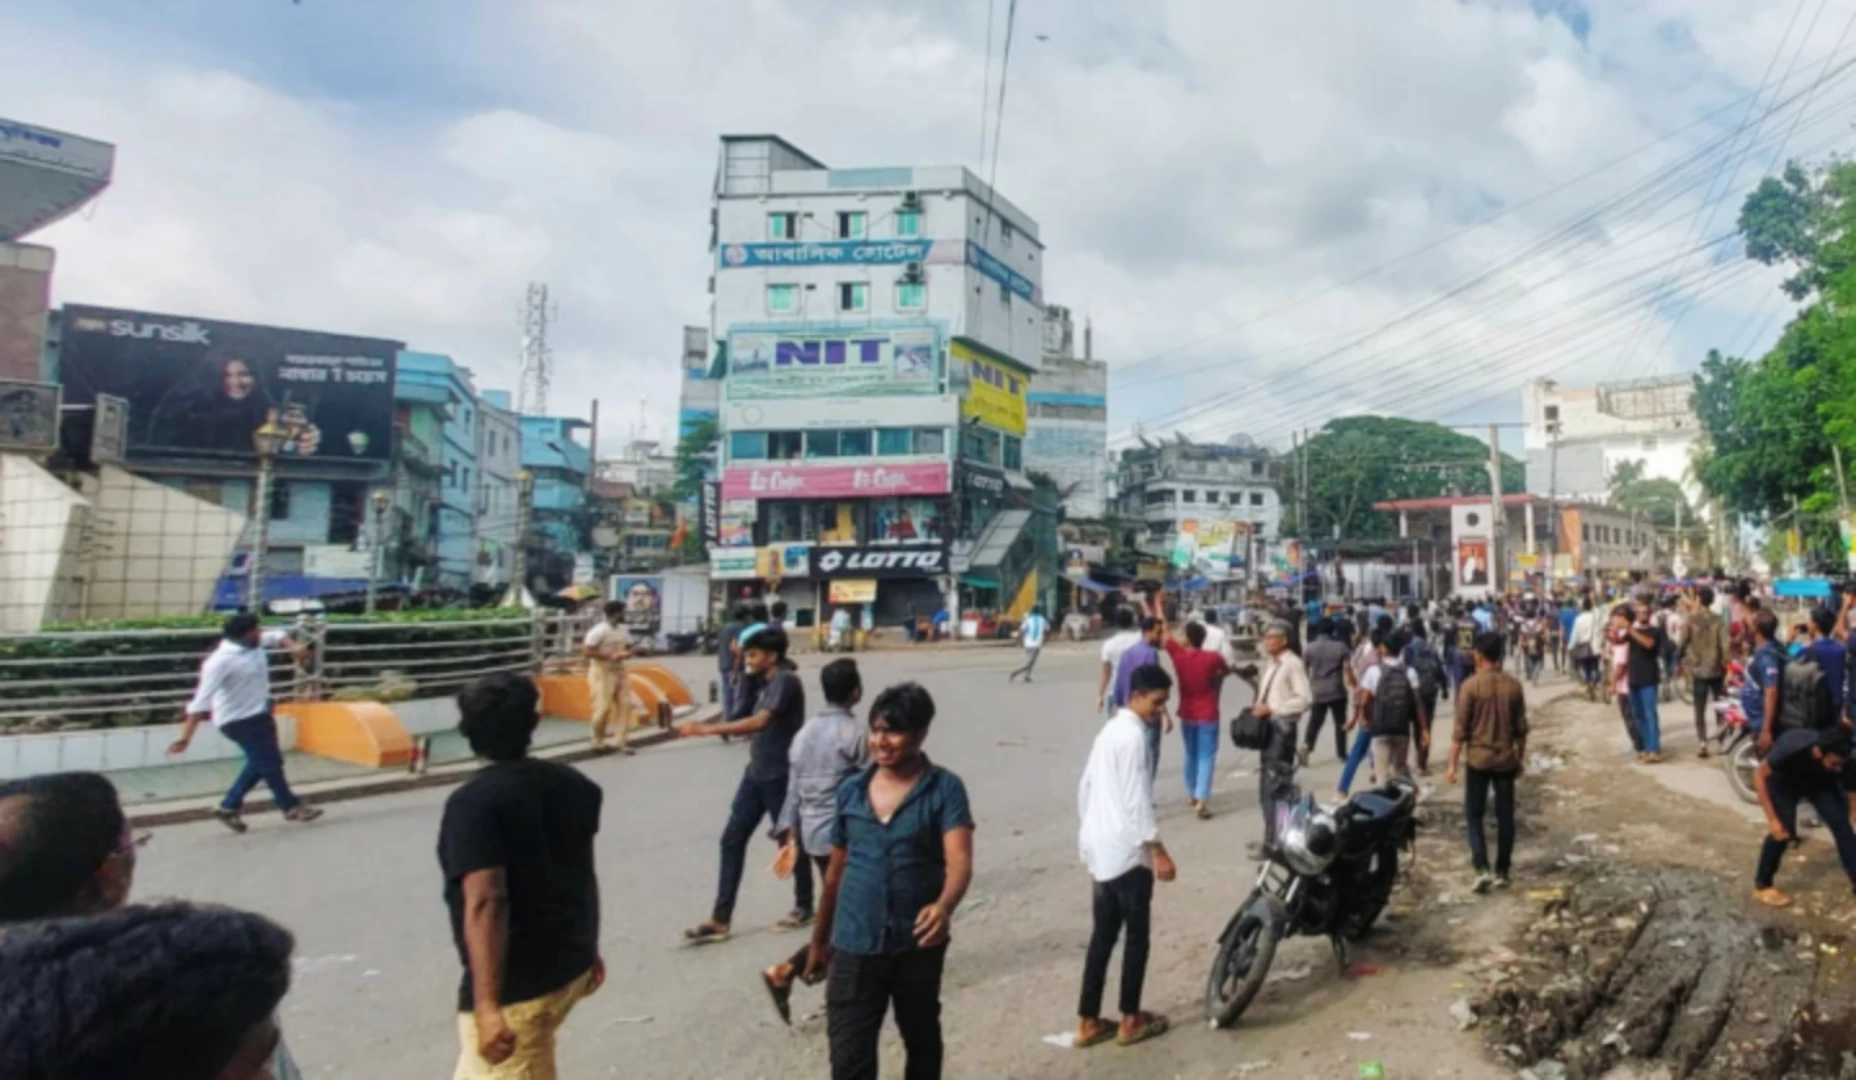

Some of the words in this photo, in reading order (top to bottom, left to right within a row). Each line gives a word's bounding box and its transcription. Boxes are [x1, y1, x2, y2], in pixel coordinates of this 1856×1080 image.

[753, 244, 844, 262] আবাসিক
[852, 242, 924, 261] হোটেল
[110, 319, 211, 345] sunsilk
[776, 337, 892, 365] NIT
[972, 359, 1024, 396] NIT
[703, 483, 717, 539] LOTTO
[845, 550, 943, 569] LOTTO
